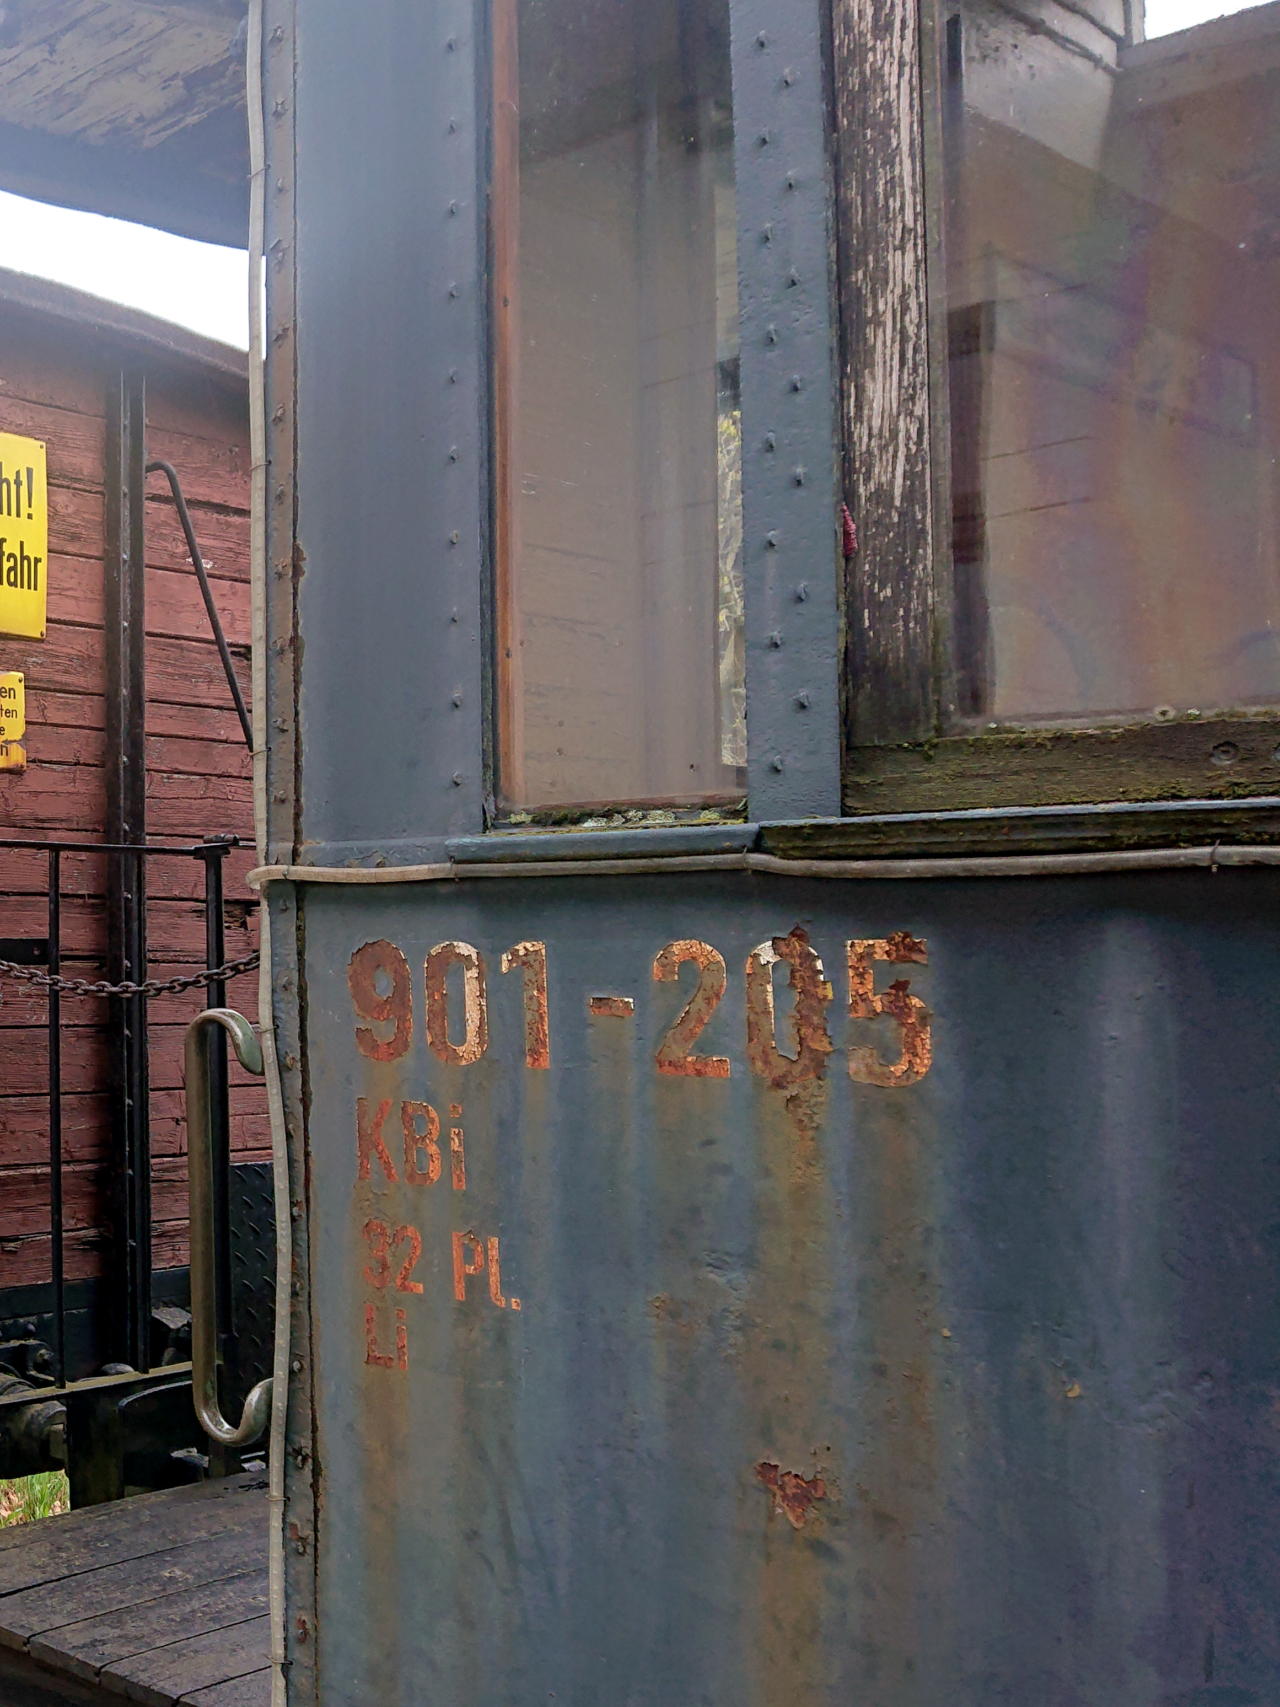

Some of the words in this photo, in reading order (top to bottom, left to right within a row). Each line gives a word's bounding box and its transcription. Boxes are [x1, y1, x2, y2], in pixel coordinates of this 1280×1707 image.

[347, 935, 934, 1089] 901-205
[355, 1097, 468, 1191] KBi
[361, 1219, 425, 1295] 32
[364, 1303, 410, 1371] Li
